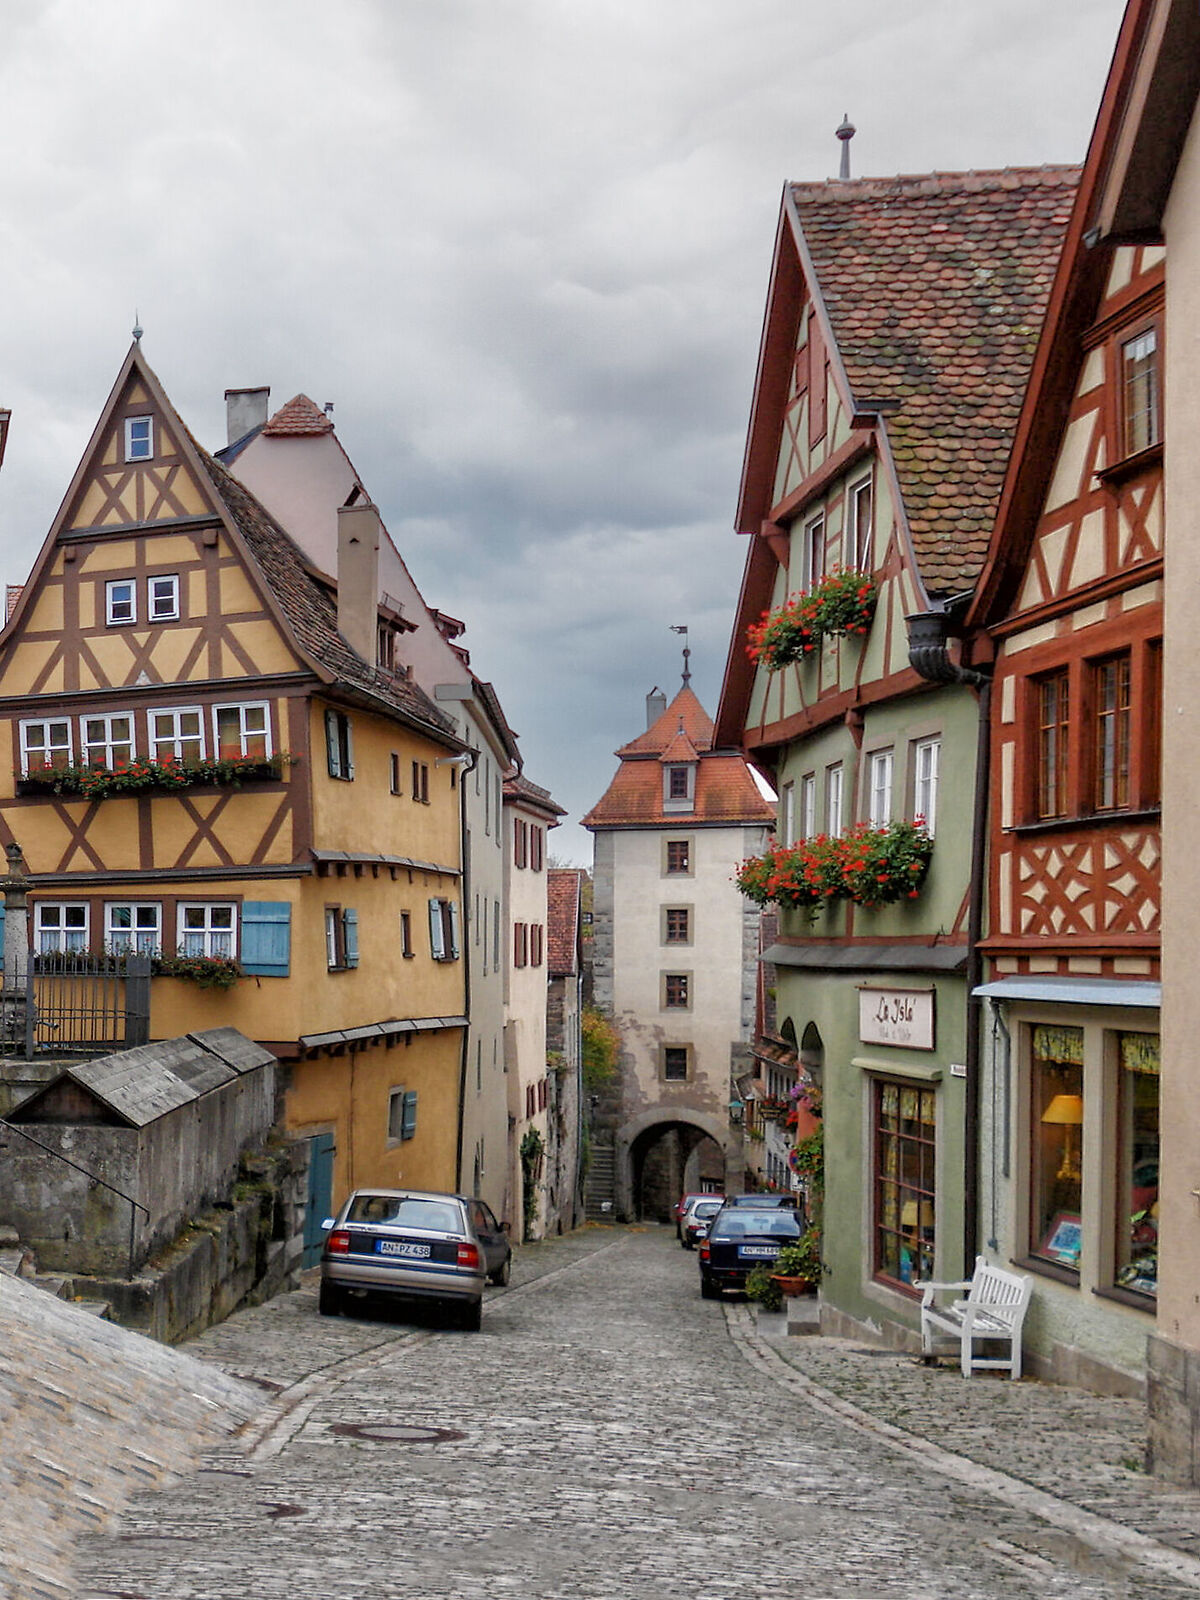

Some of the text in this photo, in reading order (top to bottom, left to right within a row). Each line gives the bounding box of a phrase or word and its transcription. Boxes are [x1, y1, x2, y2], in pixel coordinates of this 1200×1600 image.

[382, 1242, 430, 1257] AN PZ 438
